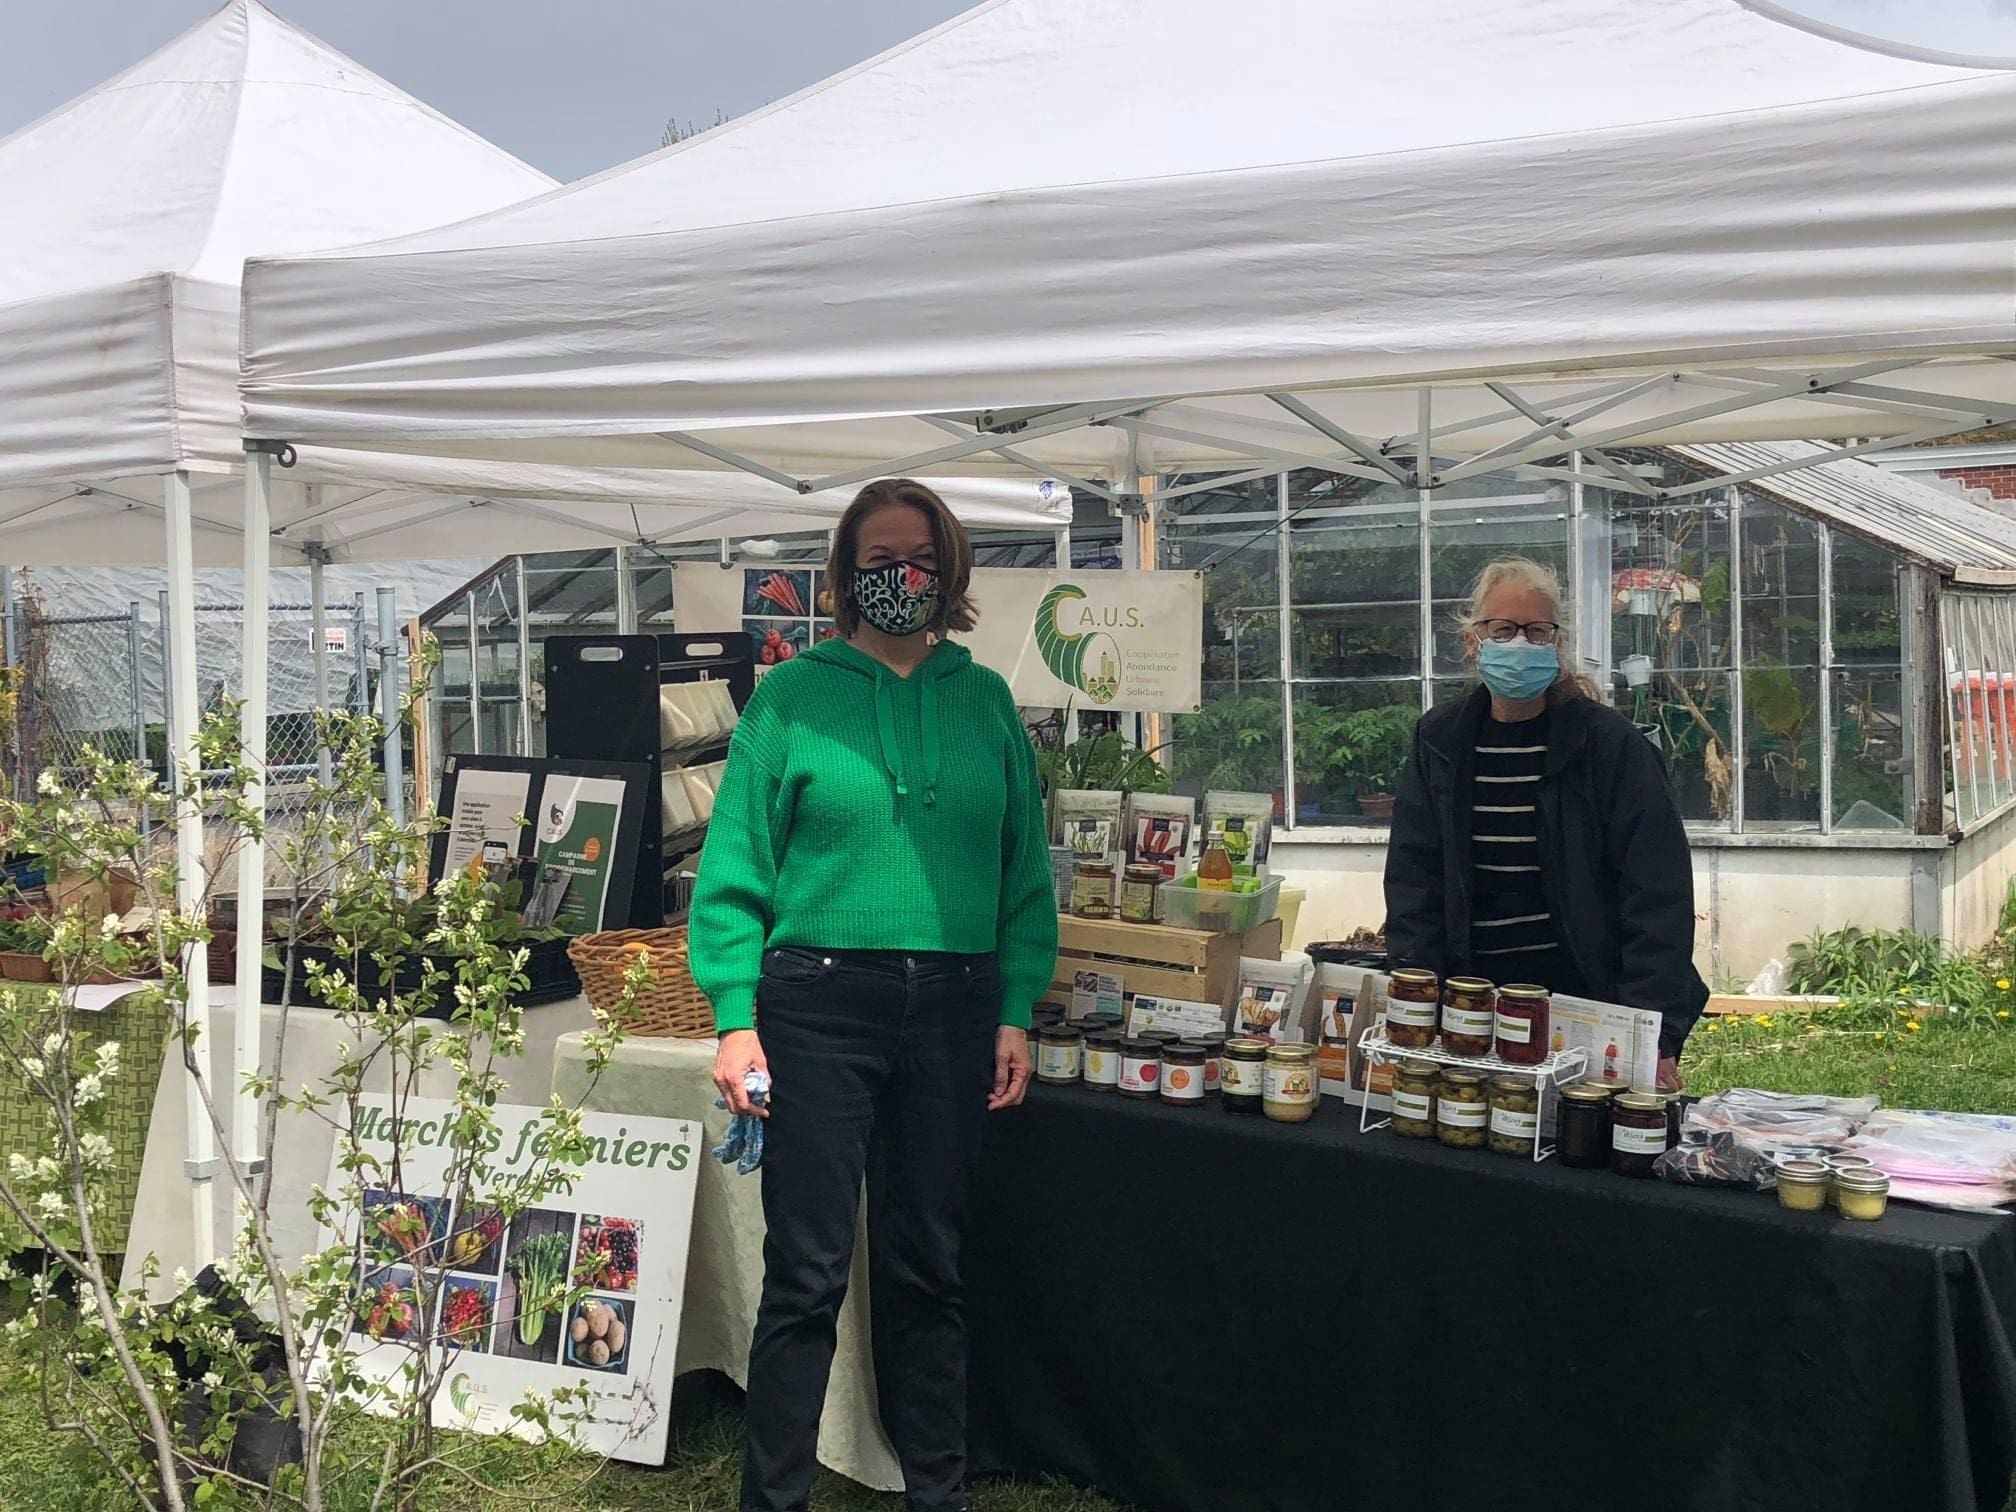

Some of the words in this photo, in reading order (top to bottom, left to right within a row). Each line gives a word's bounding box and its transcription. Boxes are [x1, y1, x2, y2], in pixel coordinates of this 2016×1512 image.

[1126, 662, 1178, 672] Abondance
[349, 1105, 503, 1153] Marchs
[505, 1119, 691, 1171] femiers
